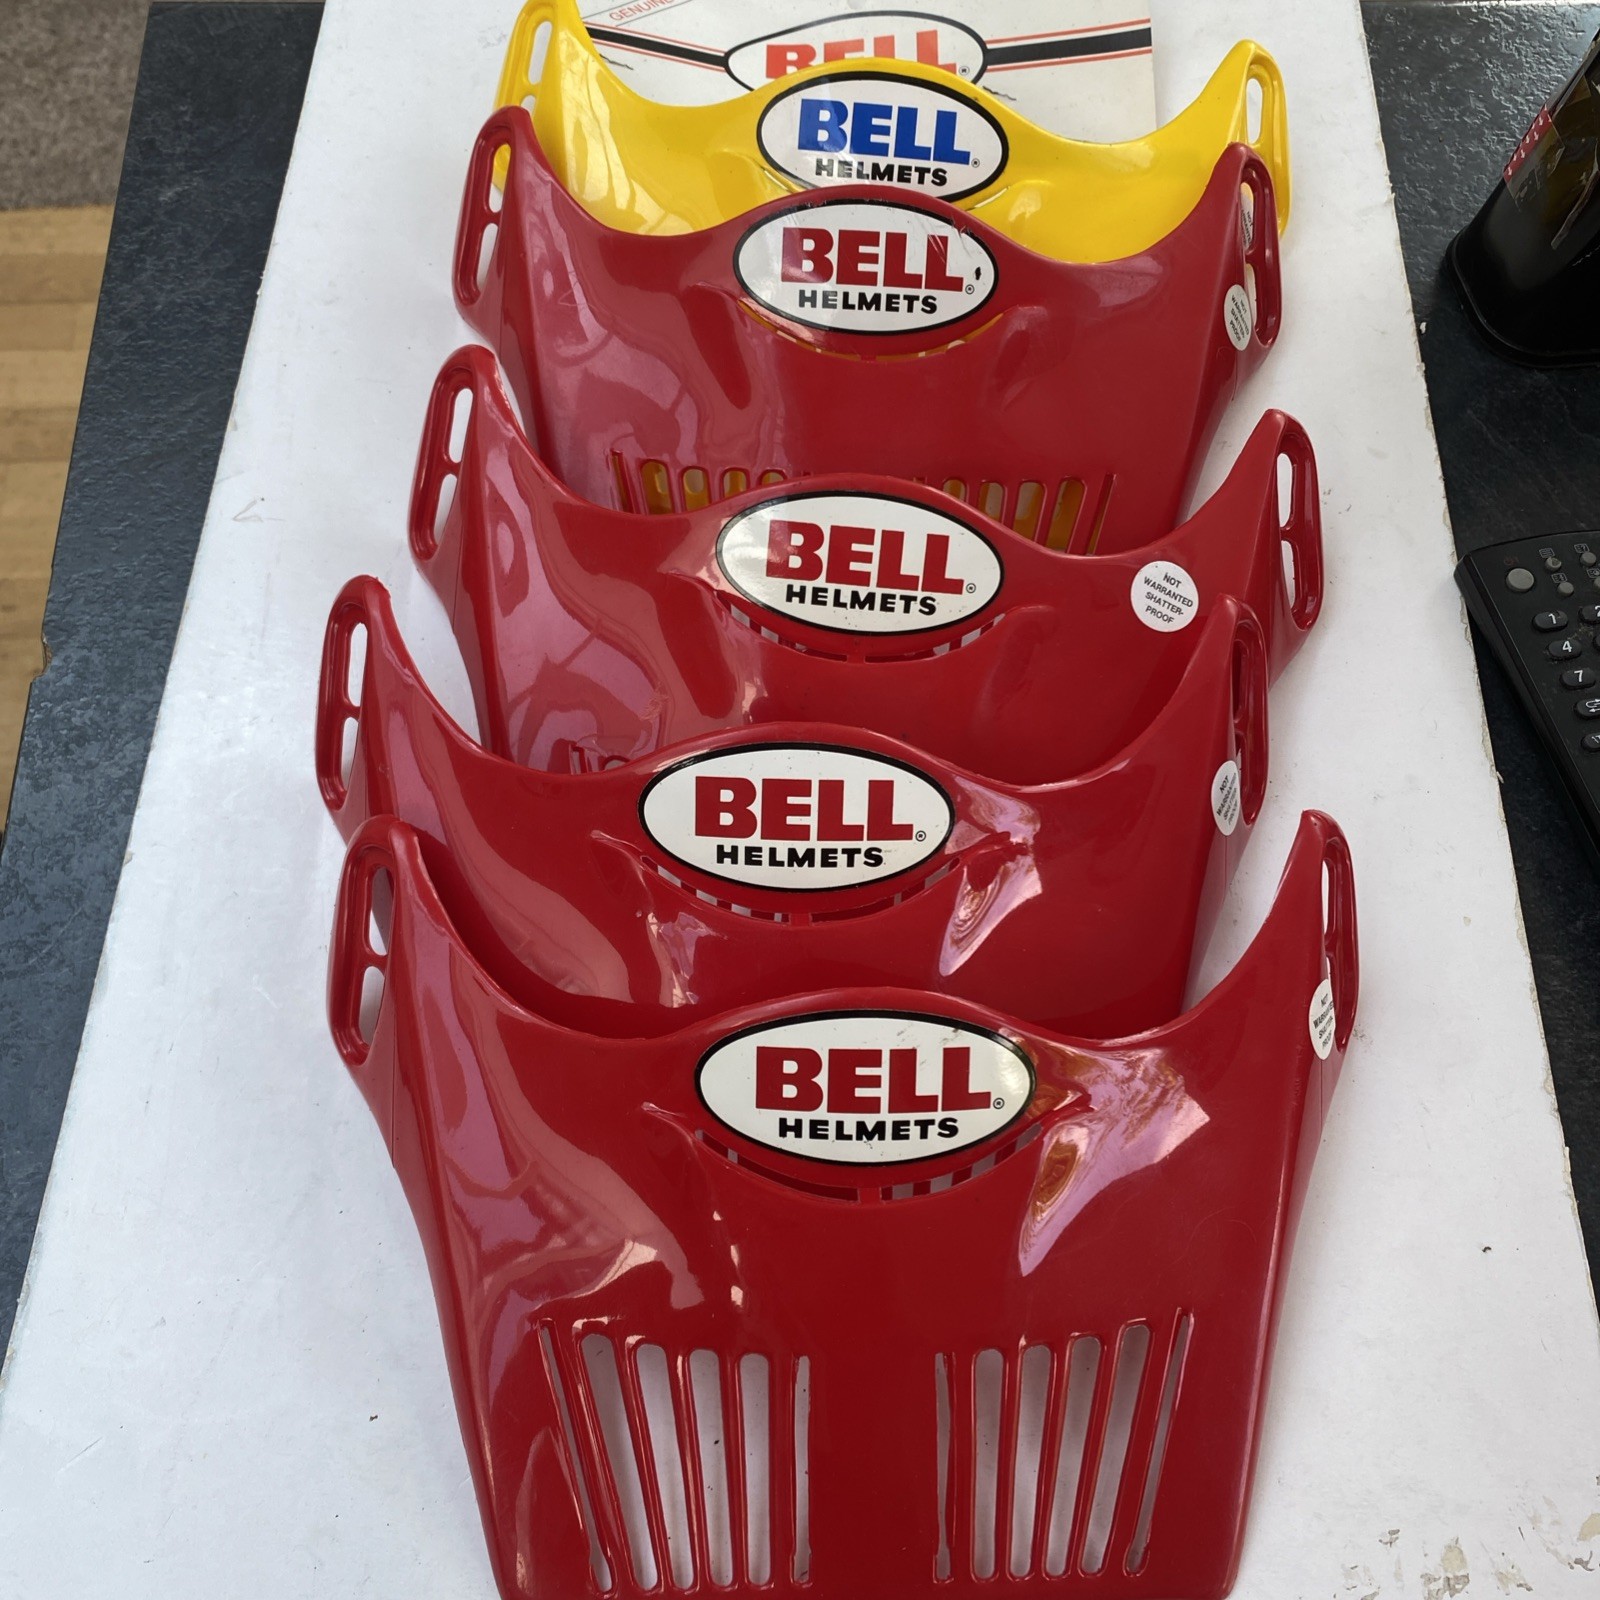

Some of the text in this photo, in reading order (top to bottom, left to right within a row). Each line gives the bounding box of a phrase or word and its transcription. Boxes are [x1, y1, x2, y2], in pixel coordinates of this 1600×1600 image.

[798, 98, 971, 165] BELL
[815, 158, 948, 186] HELMETS
[781, 227, 964, 292] BELL
[799, 289, 938, 314] HELMETS
[766, 519, 964, 595] BELL
[1143, 576, 1194, 607] WARRANTED
[1163, 572, 1182, 588] NOT
[785, 584, 937, 616] HELMETS
[1145, 591, 1184, 616] SHATTER-
[1145, 605, 1174, 624] PROOF
[1548, 613, 1557, 624] 1
[1562, 640, 1572, 653] 4
[1574, 669, 1583, 682] 7
[695, 776, 914, 841] BELL
[716, 844, 884, 867] HELMETS
[756, 1046, 991, 1114] BELL
[779, 1117, 959, 1141] HELMETS
